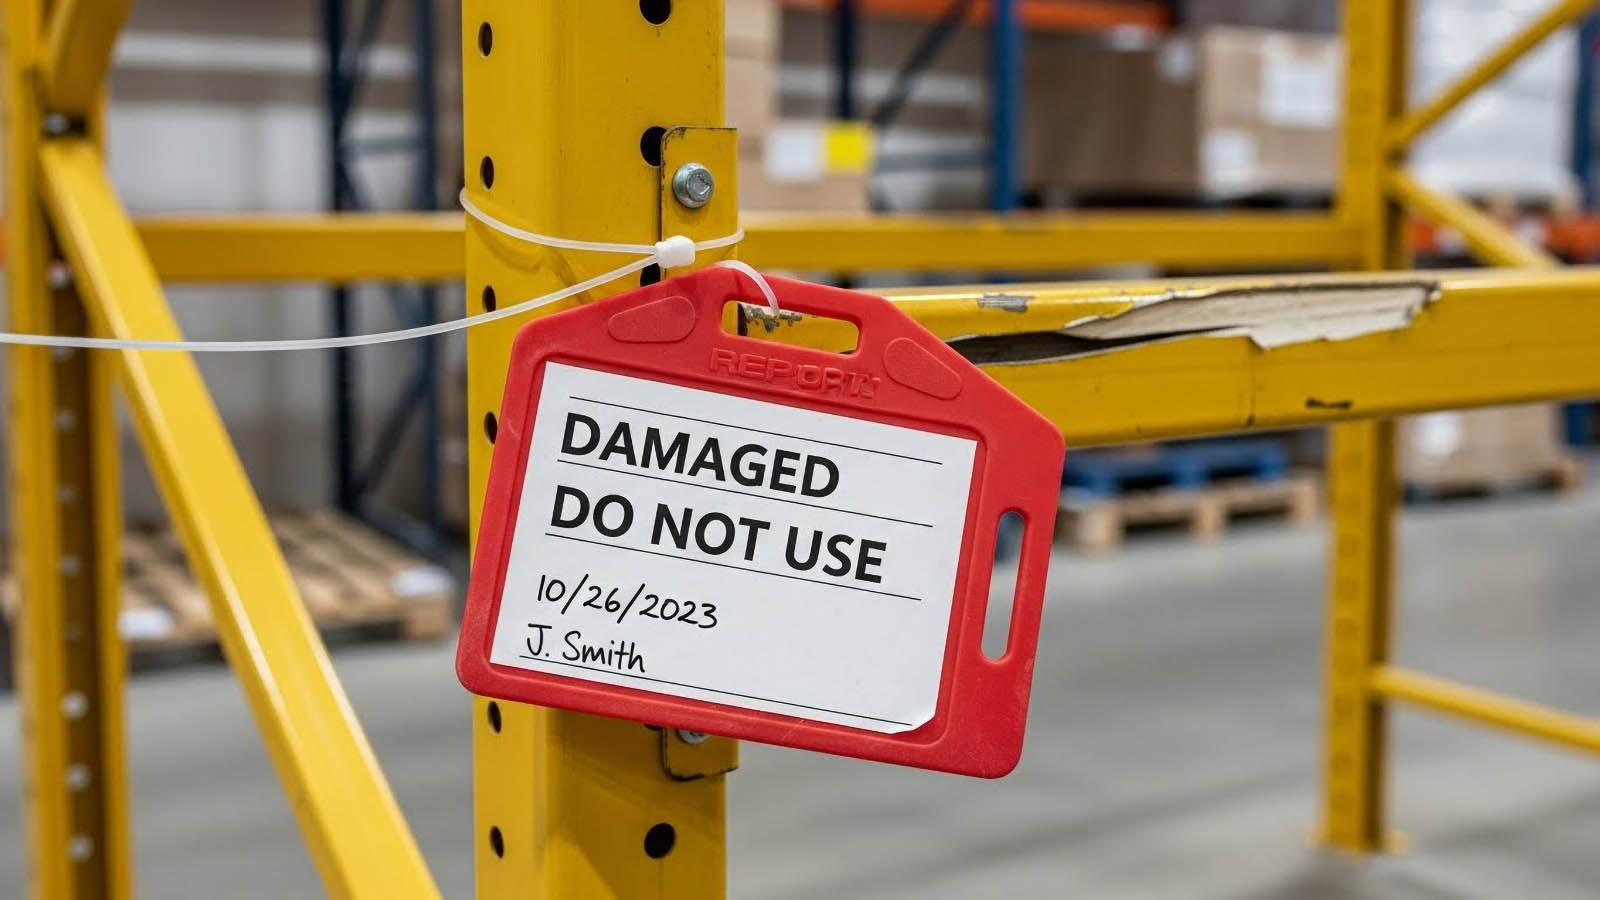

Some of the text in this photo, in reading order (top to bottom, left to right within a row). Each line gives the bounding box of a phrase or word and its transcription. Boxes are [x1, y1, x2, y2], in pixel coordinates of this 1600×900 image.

[560, 412, 840, 498] DAMAGED
[550, 484, 888, 584] DO NOT USE
[537, 573, 718, 629] 10/26/2023
[526, 623, 646, 673] J. Smith
